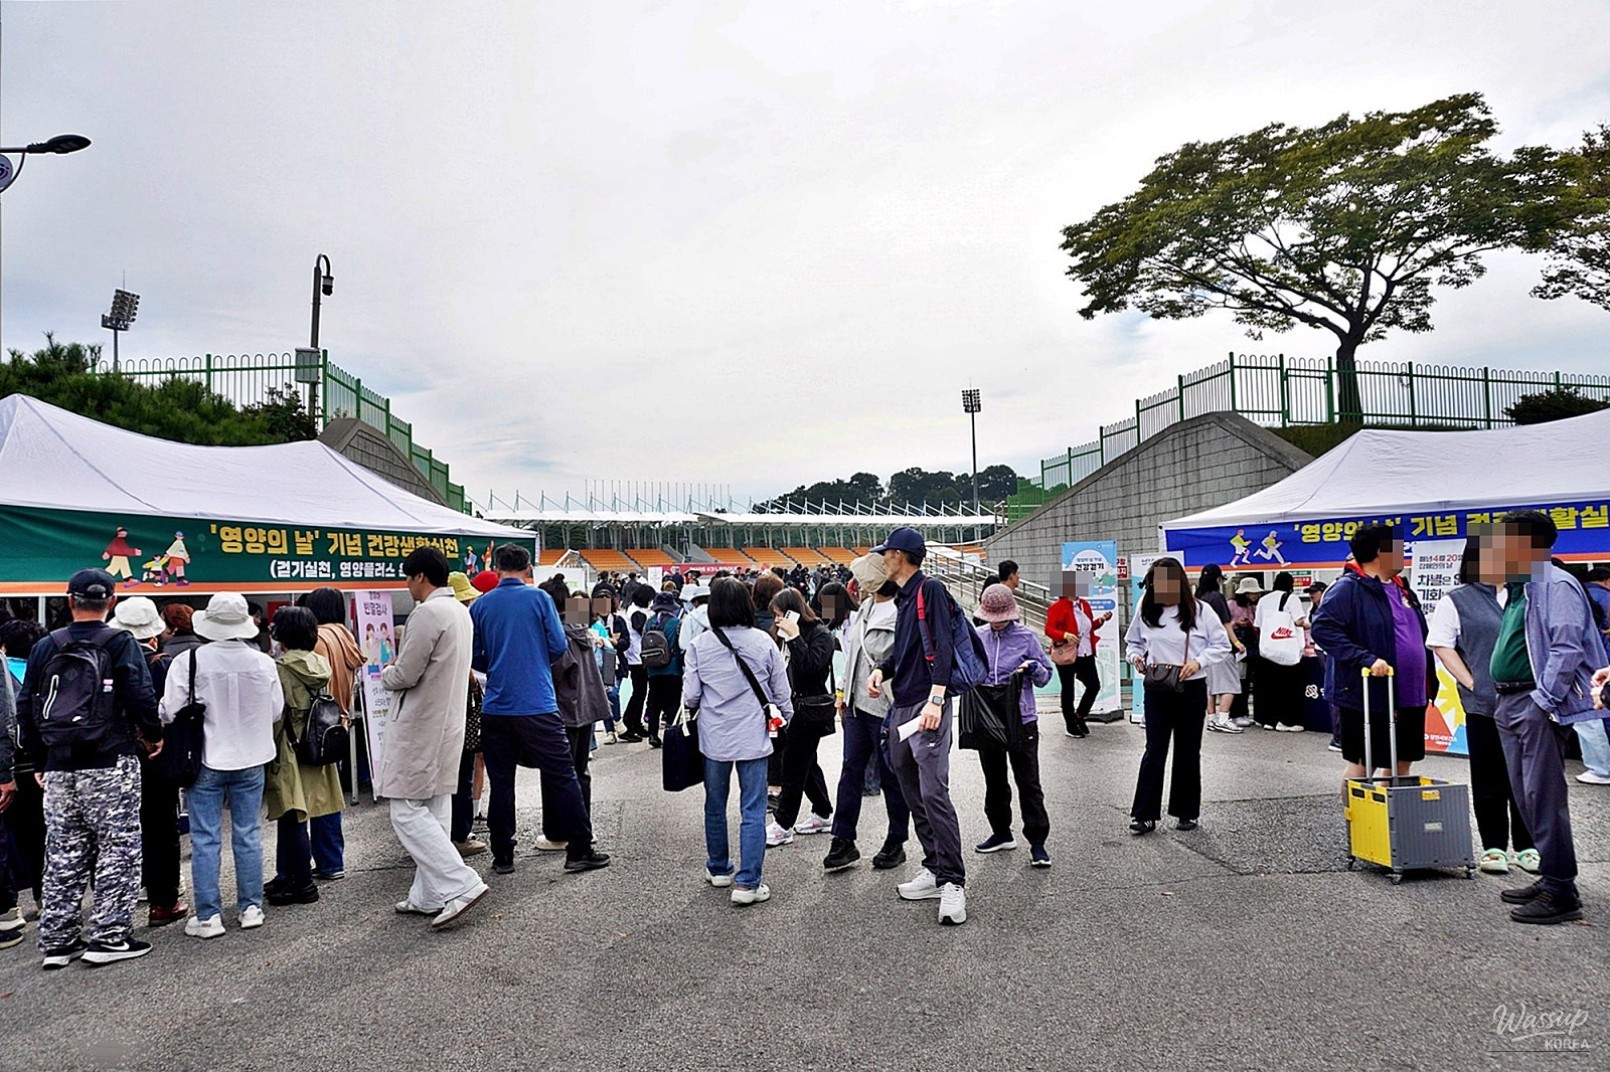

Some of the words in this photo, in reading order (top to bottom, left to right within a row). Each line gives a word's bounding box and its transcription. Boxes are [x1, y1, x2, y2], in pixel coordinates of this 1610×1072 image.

[1411, 514, 1458, 537] 기념
[210, 524, 288, 554] '영양의
[294, 530, 319, 555] 날'
[327, 533, 362, 557] 기념
[270, 559, 335, 579] (걷기실천,
[340, 561, 395, 577] 영양플러스
[1075, 562, 1104, 571] 건강걷기
[1417, 574, 1451, 586] 차별은
[1417, 588, 1447, 601] 기회
